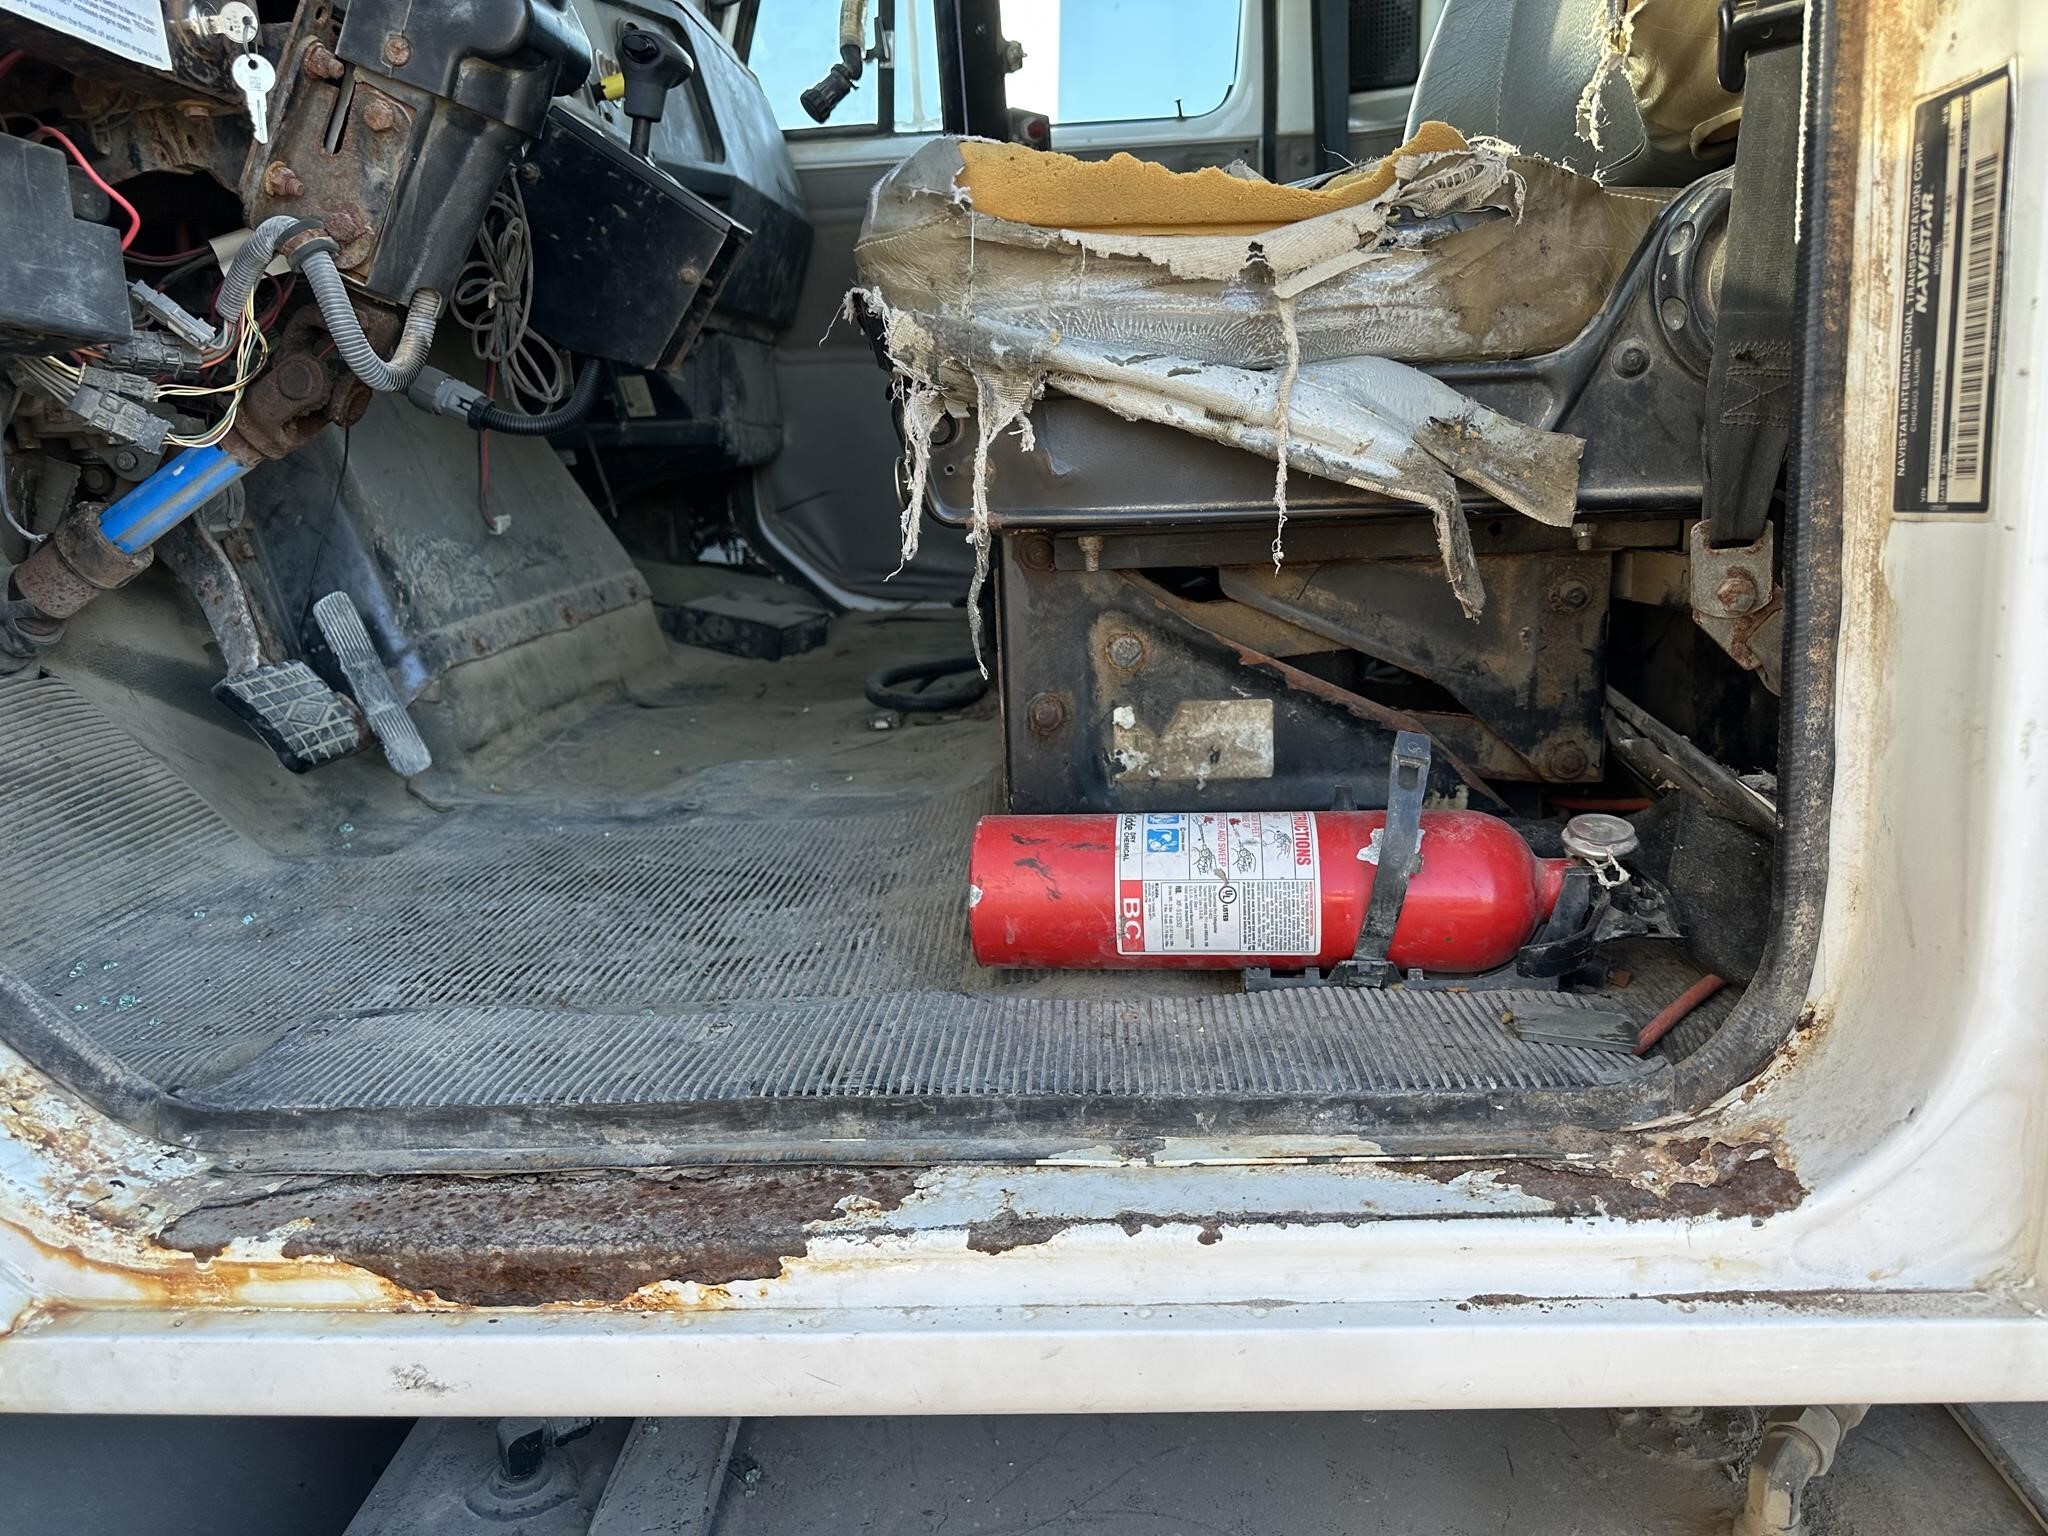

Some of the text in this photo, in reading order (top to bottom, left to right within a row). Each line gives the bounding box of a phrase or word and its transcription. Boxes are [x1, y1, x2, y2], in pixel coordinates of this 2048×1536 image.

[1906, 184, 1921, 305] TRANSPORTATION
[1915, 192, 1934, 313] NAVISTAR
[1901, 308, 1915, 411] INTERNATIONAL
[1912, 347, 1922, 387] ILLINOIS
[1897, 413, 1909, 477] NAVISTAR
[1217, 830, 1226, 842] AND
[1217, 843, 1227, 867] SWEEP
[1122, 897, 1142, 941] BC
